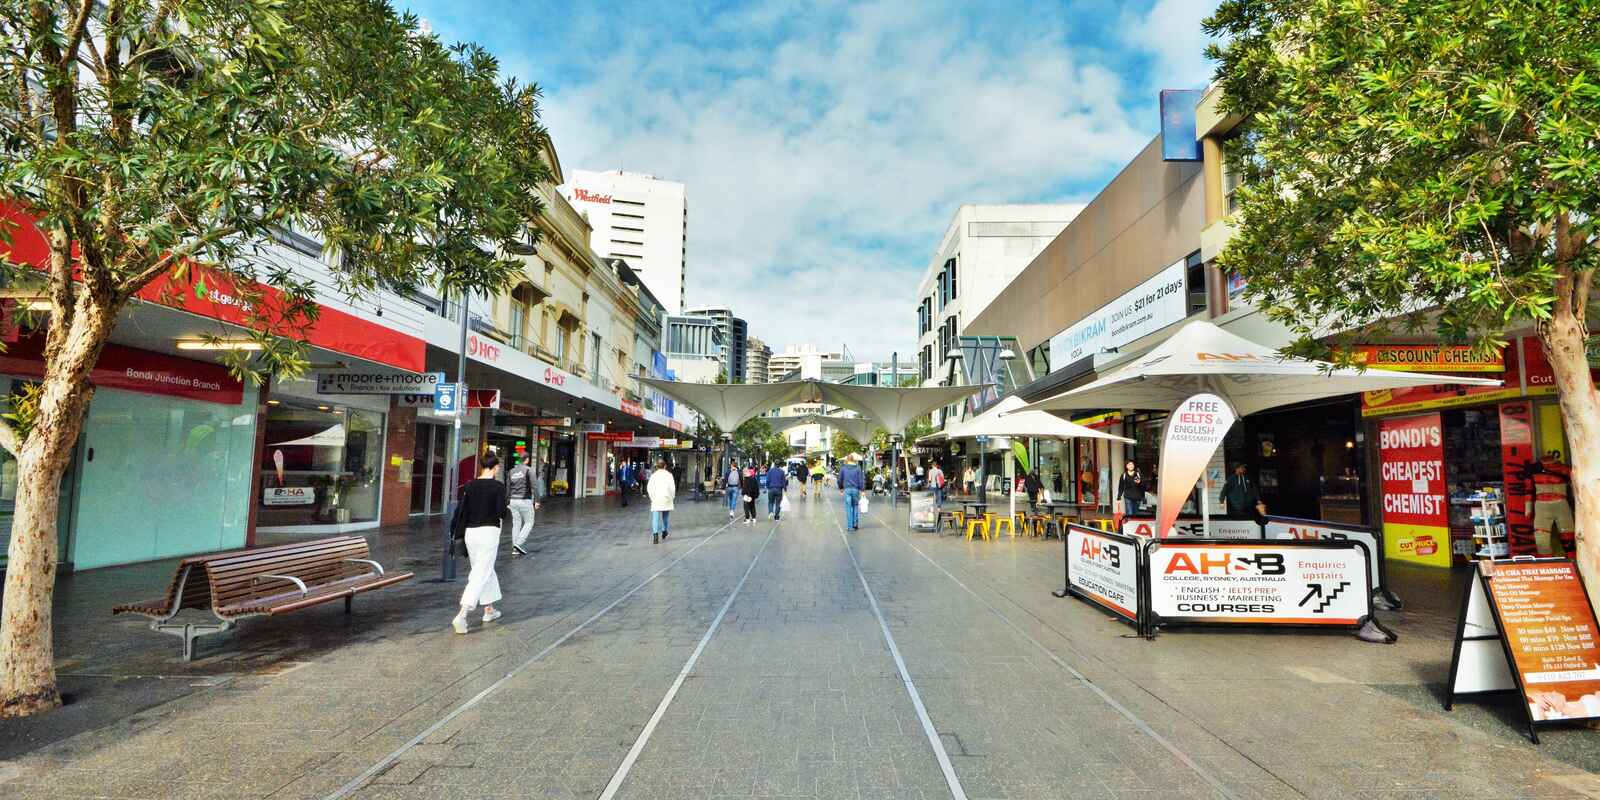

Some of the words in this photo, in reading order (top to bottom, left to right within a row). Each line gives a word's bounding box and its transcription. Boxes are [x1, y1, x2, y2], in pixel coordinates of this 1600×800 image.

[574, 188, 613, 205] Westfield
[1134, 295, 1145, 312] $21
[1146, 293, 1156, 305] for
[1157, 287, 1164, 299] 21
[1164, 279, 1183, 295] days
[1073, 318, 1106, 348] BIKRAM
[479, 341, 501, 362] HCF
[126, 368, 153, 380] Bondi
[154, 373, 191, 386] Junction
[193, 379, 220, 390] Branch
[337, 373, 437, 384] moore+moore
[551, 374, 566, 386] HCF
[1531, 375, 1553, 384] Cut
[1189, 402, 1219, 413] FREE
[1180, 413, 1214, 425] IELTS
[1174, 425, 1215, 435] ENGLISH
[1171, 434, 1218, 443] ASSESSMENT
[1380, 426, 1441, 449] BONDI'S
[1382, 460, 1442, 481] CHEAPEST
[1164, 552, 1286, 576] AH&B
[1297, 561, 1346, 570] Enquiries
[1302, 572, 1344, 582] upstairs
[1078, 576, 1108, 596] EDUCATION
[1108, 590, 1125, 604] CAFE
[1227, 595, 1282, 603] MARKETING
[1177, 603, 1275, 613] COURSES
